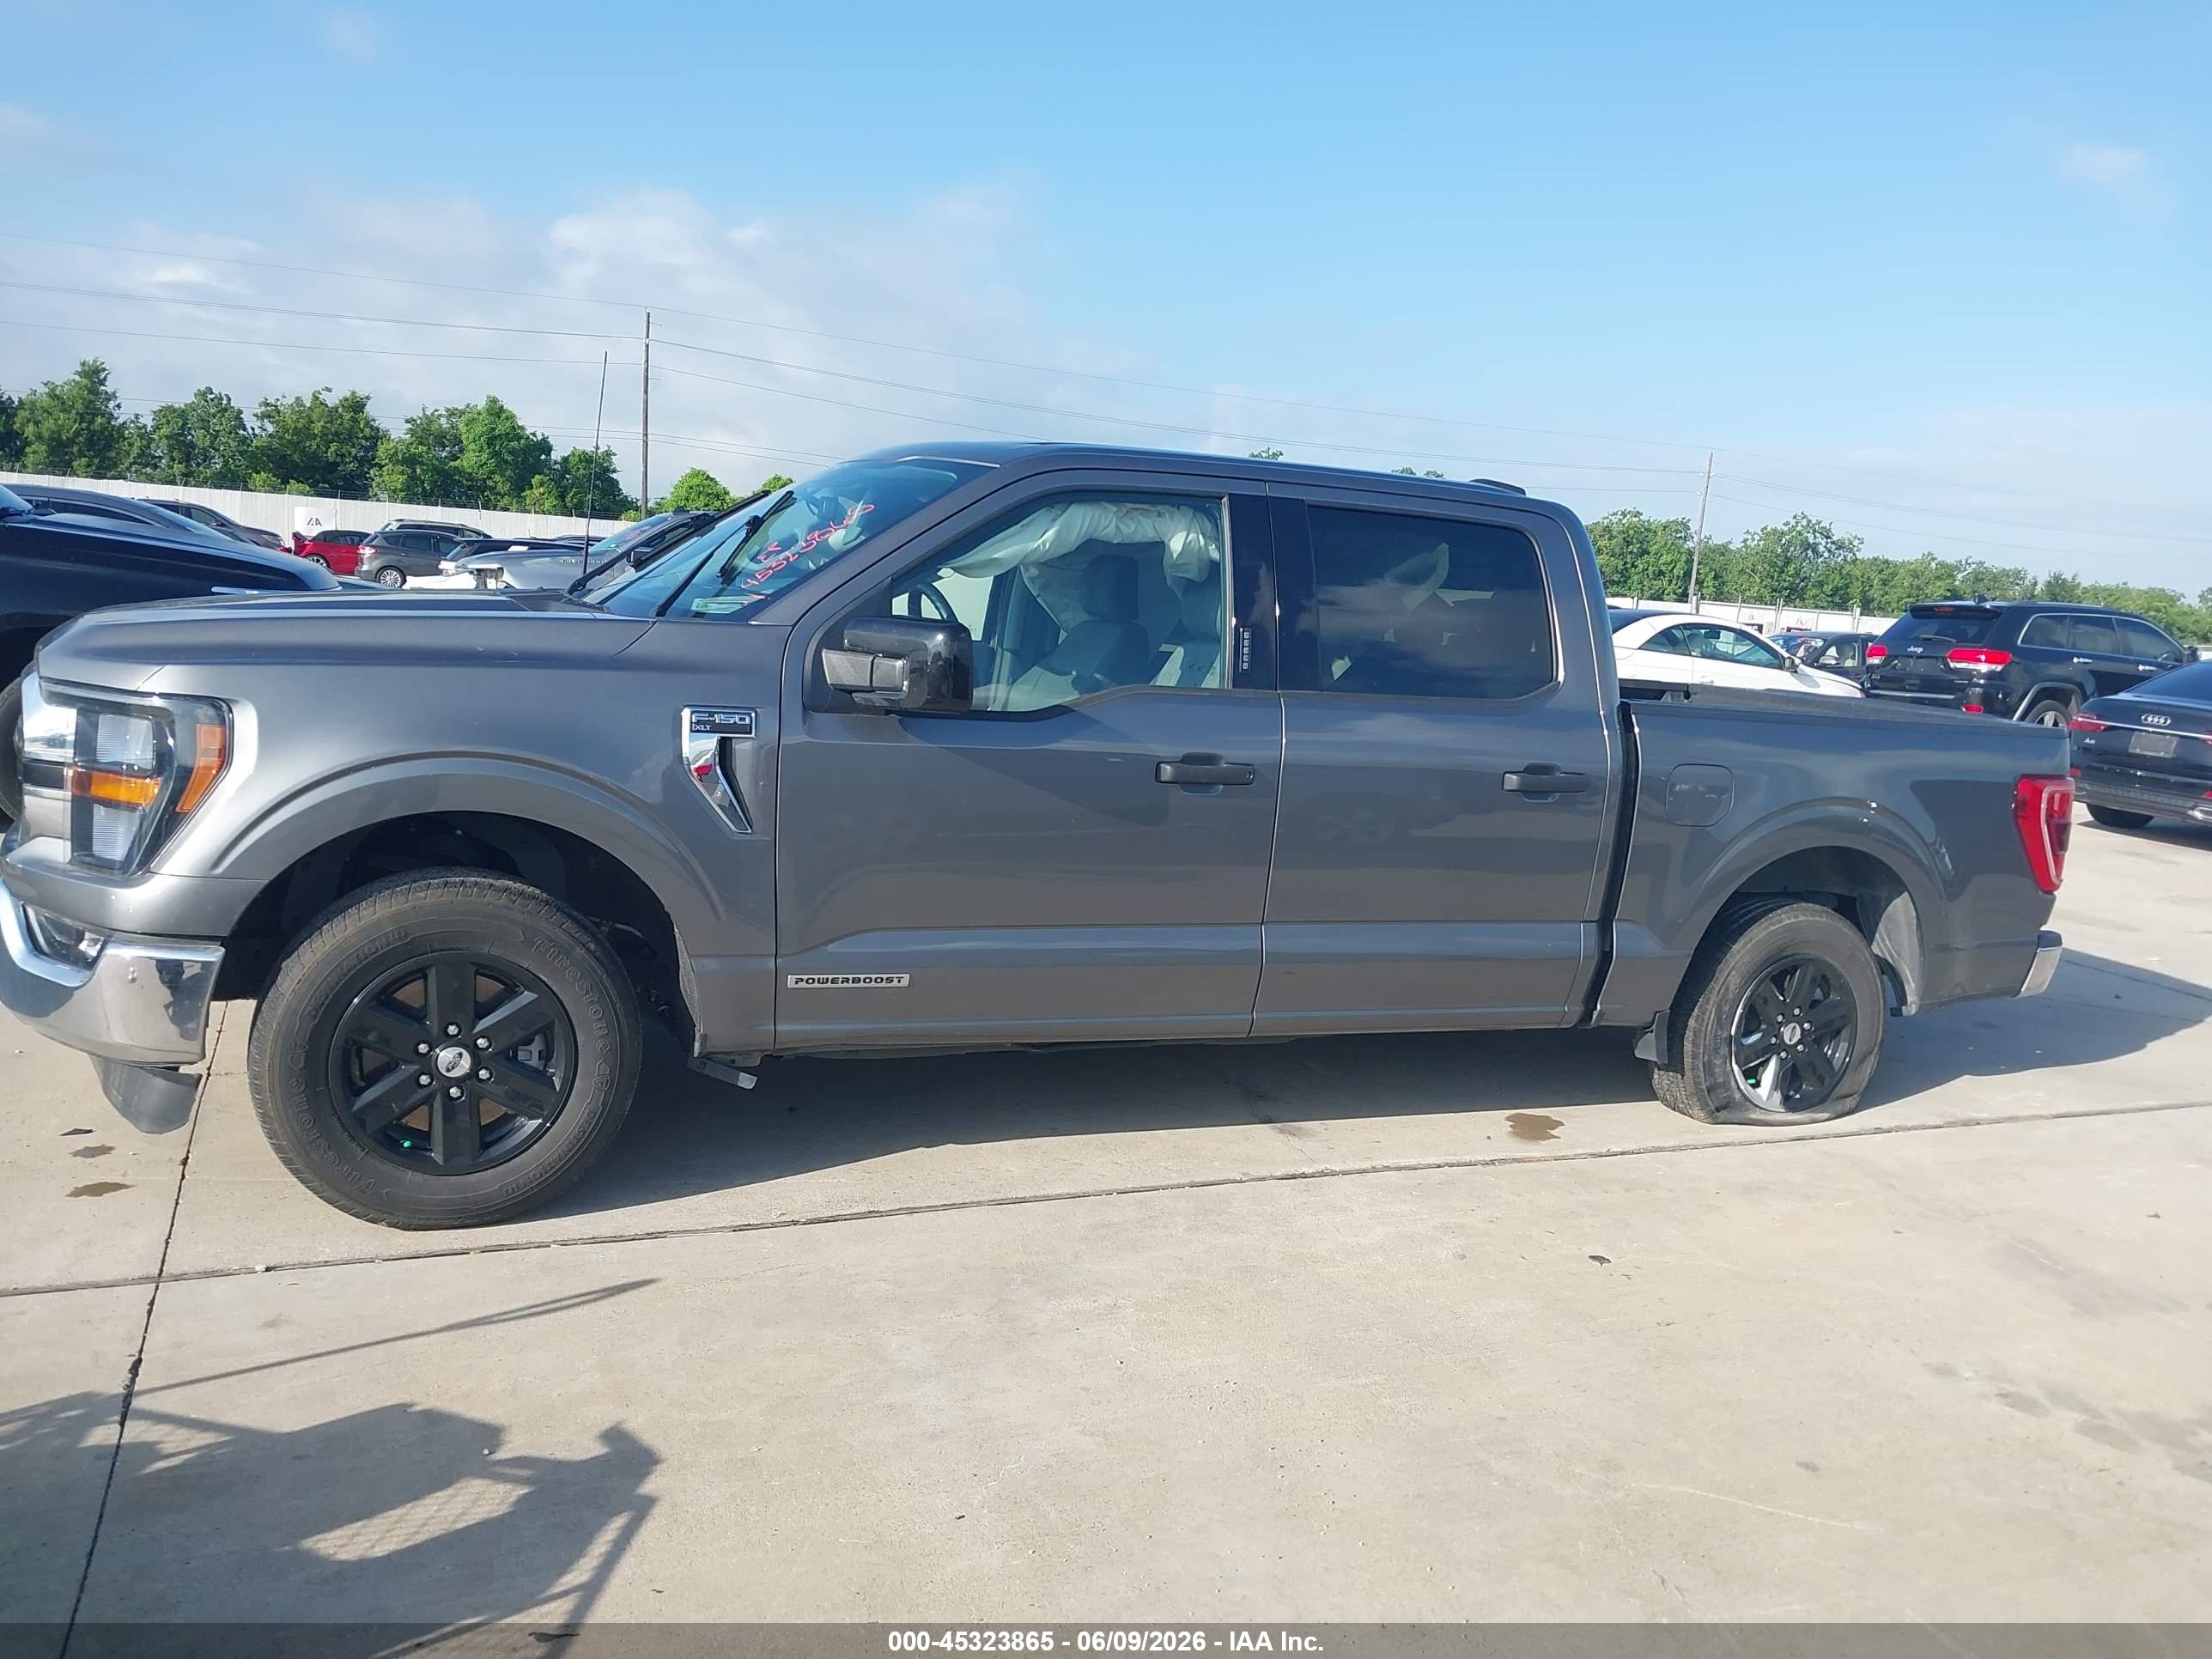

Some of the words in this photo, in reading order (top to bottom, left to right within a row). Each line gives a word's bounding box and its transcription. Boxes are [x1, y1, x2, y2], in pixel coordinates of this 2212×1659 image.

[1907, 645, 1923, 653] Jeep
[692, 714, 750, 725] F-150
[794, 976, 904, 985] POWERBOOST
[532, 935, 611, 1054] Firestone
[289, 1078, 378, 1196] Firestone
